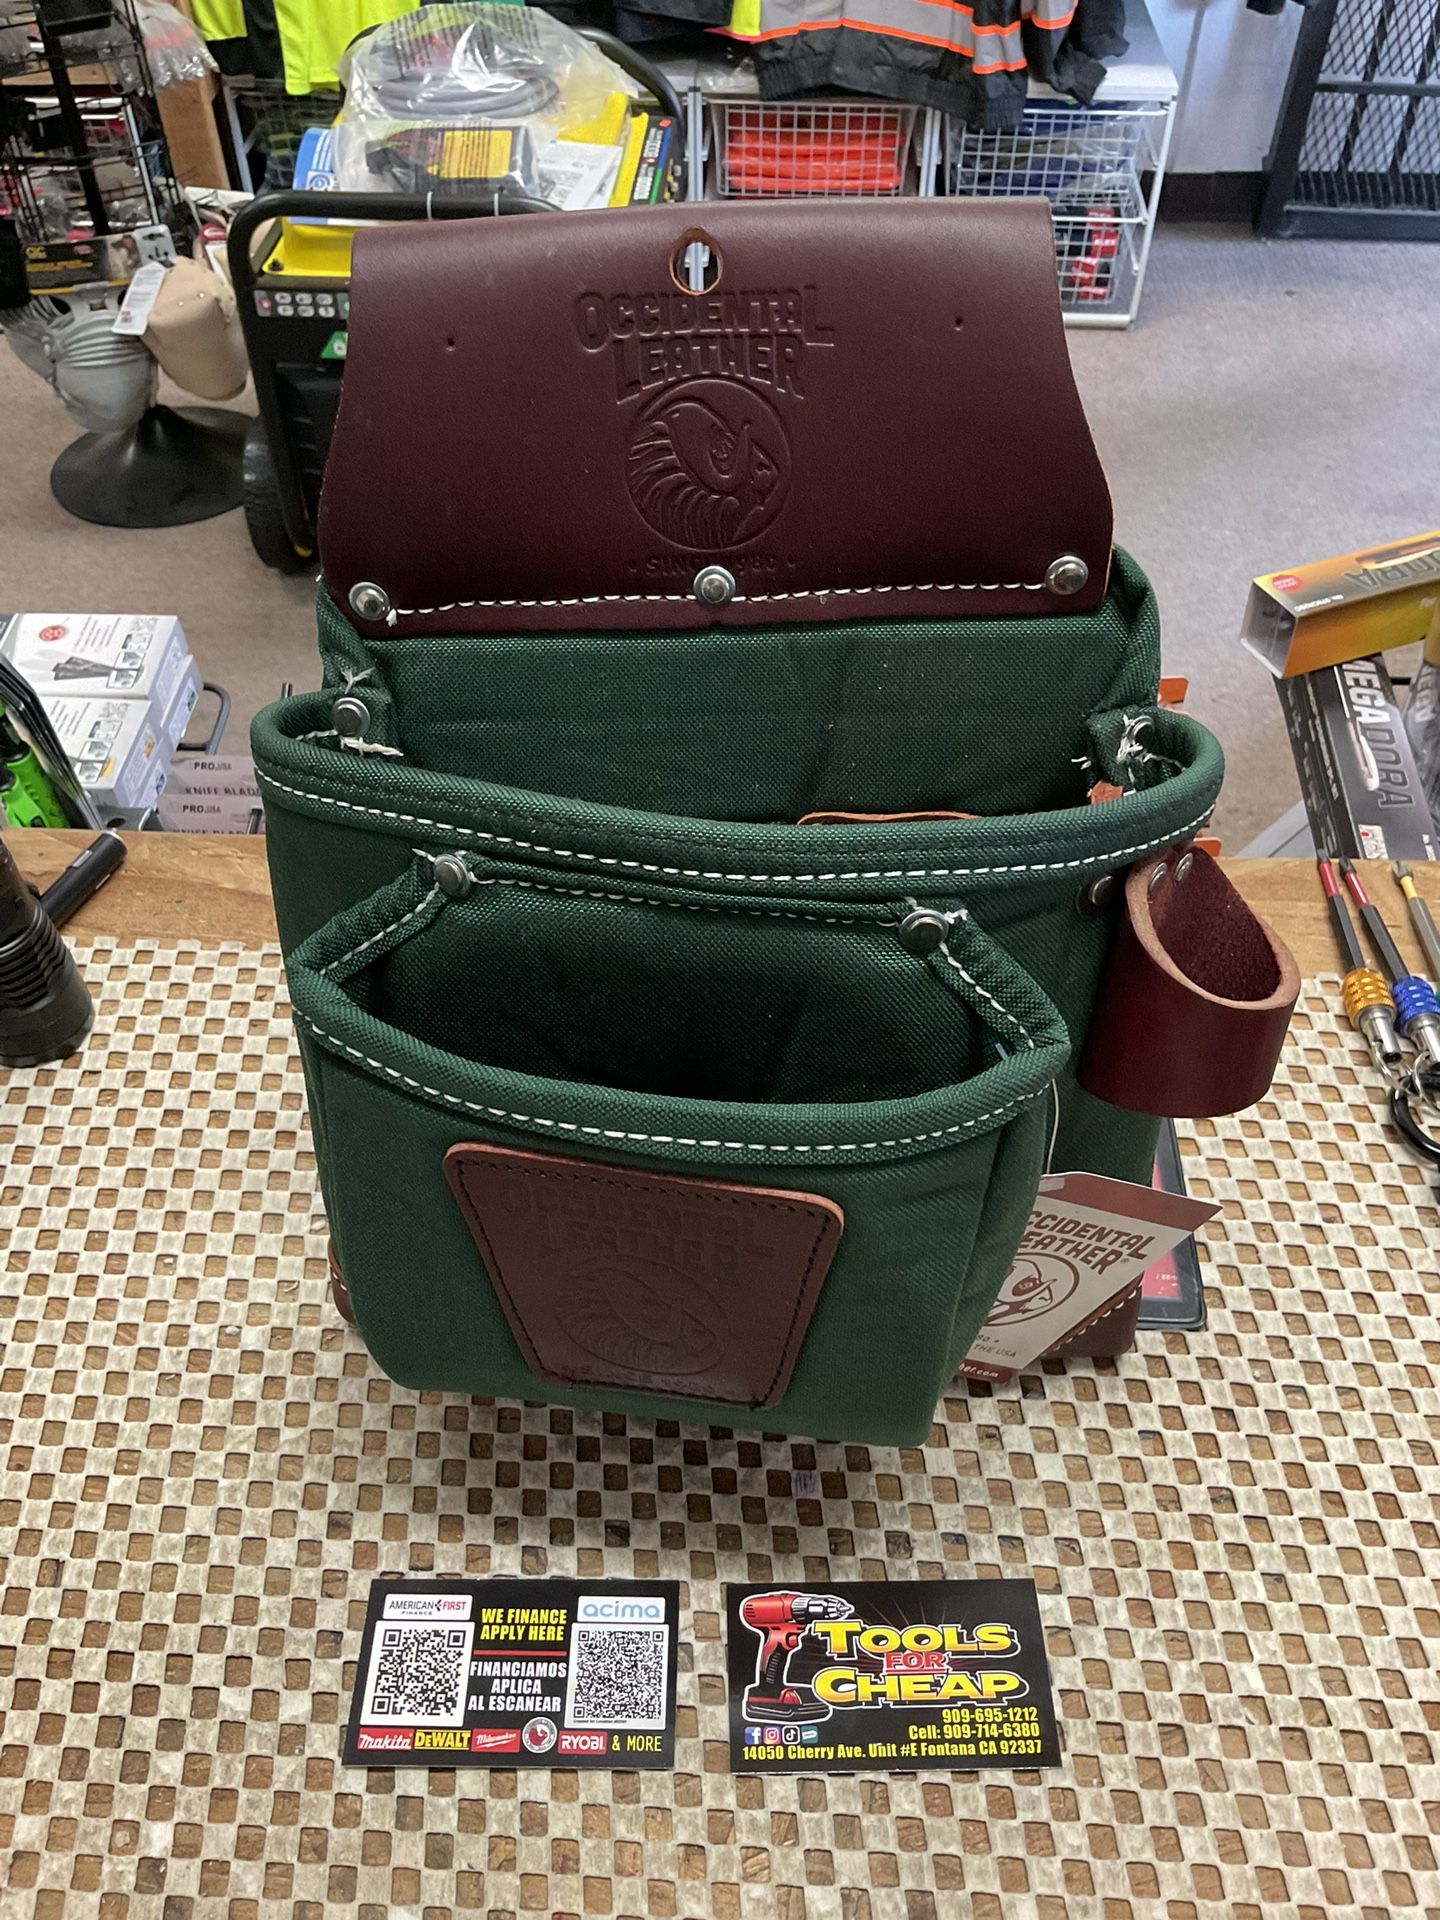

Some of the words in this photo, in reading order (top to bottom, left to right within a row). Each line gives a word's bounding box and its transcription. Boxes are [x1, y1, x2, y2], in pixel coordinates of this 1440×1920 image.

[575, 284, 835, 353] OCCIDENTAL
[613, 335, 804, 404] LEATHER
[648, 552, 703, 574] SINC
[1019, 1231, 1123, 1275] EATHER
[389, 1600, 434, 1610] AMERICAN
[442, 1601, 467, 1610] FIRST
[582, 1601, 660, 1618] acima
[482, 1609, 503, 1623] WE
[507, 1609, 568, 1624] FINANCE
[480, 1625, 525, 1640] APPLY
[526, 1625, 565, 1641] HERE
[813, 1620, 1014, 1655] TOOLS
[885, 1652, 946, 1669] FOR
[469, 1662, 567, 1677] FINANCIAMOS
[491, 1679, 542, 1694] APLICA
[813, 1668, 1021, 1702] CHEAP
[467, 1695, 485, 1710] AL
[489, 1696, 561, 1712] ESCANEAR
[942, 1707, 1038, 1723] 909-695-1212
[908, 1725, 941, 1740] Cell:
[943, 1722, 1040, 1739] 909-714-6380
[561, 1735, 604, 1750] RYOBI
[611, 1734, 621, 1751] &
[626, 1735, 662, 1752] MORE
[743, 1745, 784, 1760] 14050
[788, 1744, 834, 1760] Cherry
[837, 1743, 866, 1758] Ave.
[868, 1743, 898, 1758] Unit
[900, 1742, 917, 1757] #E
[921, 1742, 976, 1756] Fontana
[979, 1741, 997, 1755] CA
[1000, 1740, 1042, 1754] 92337
